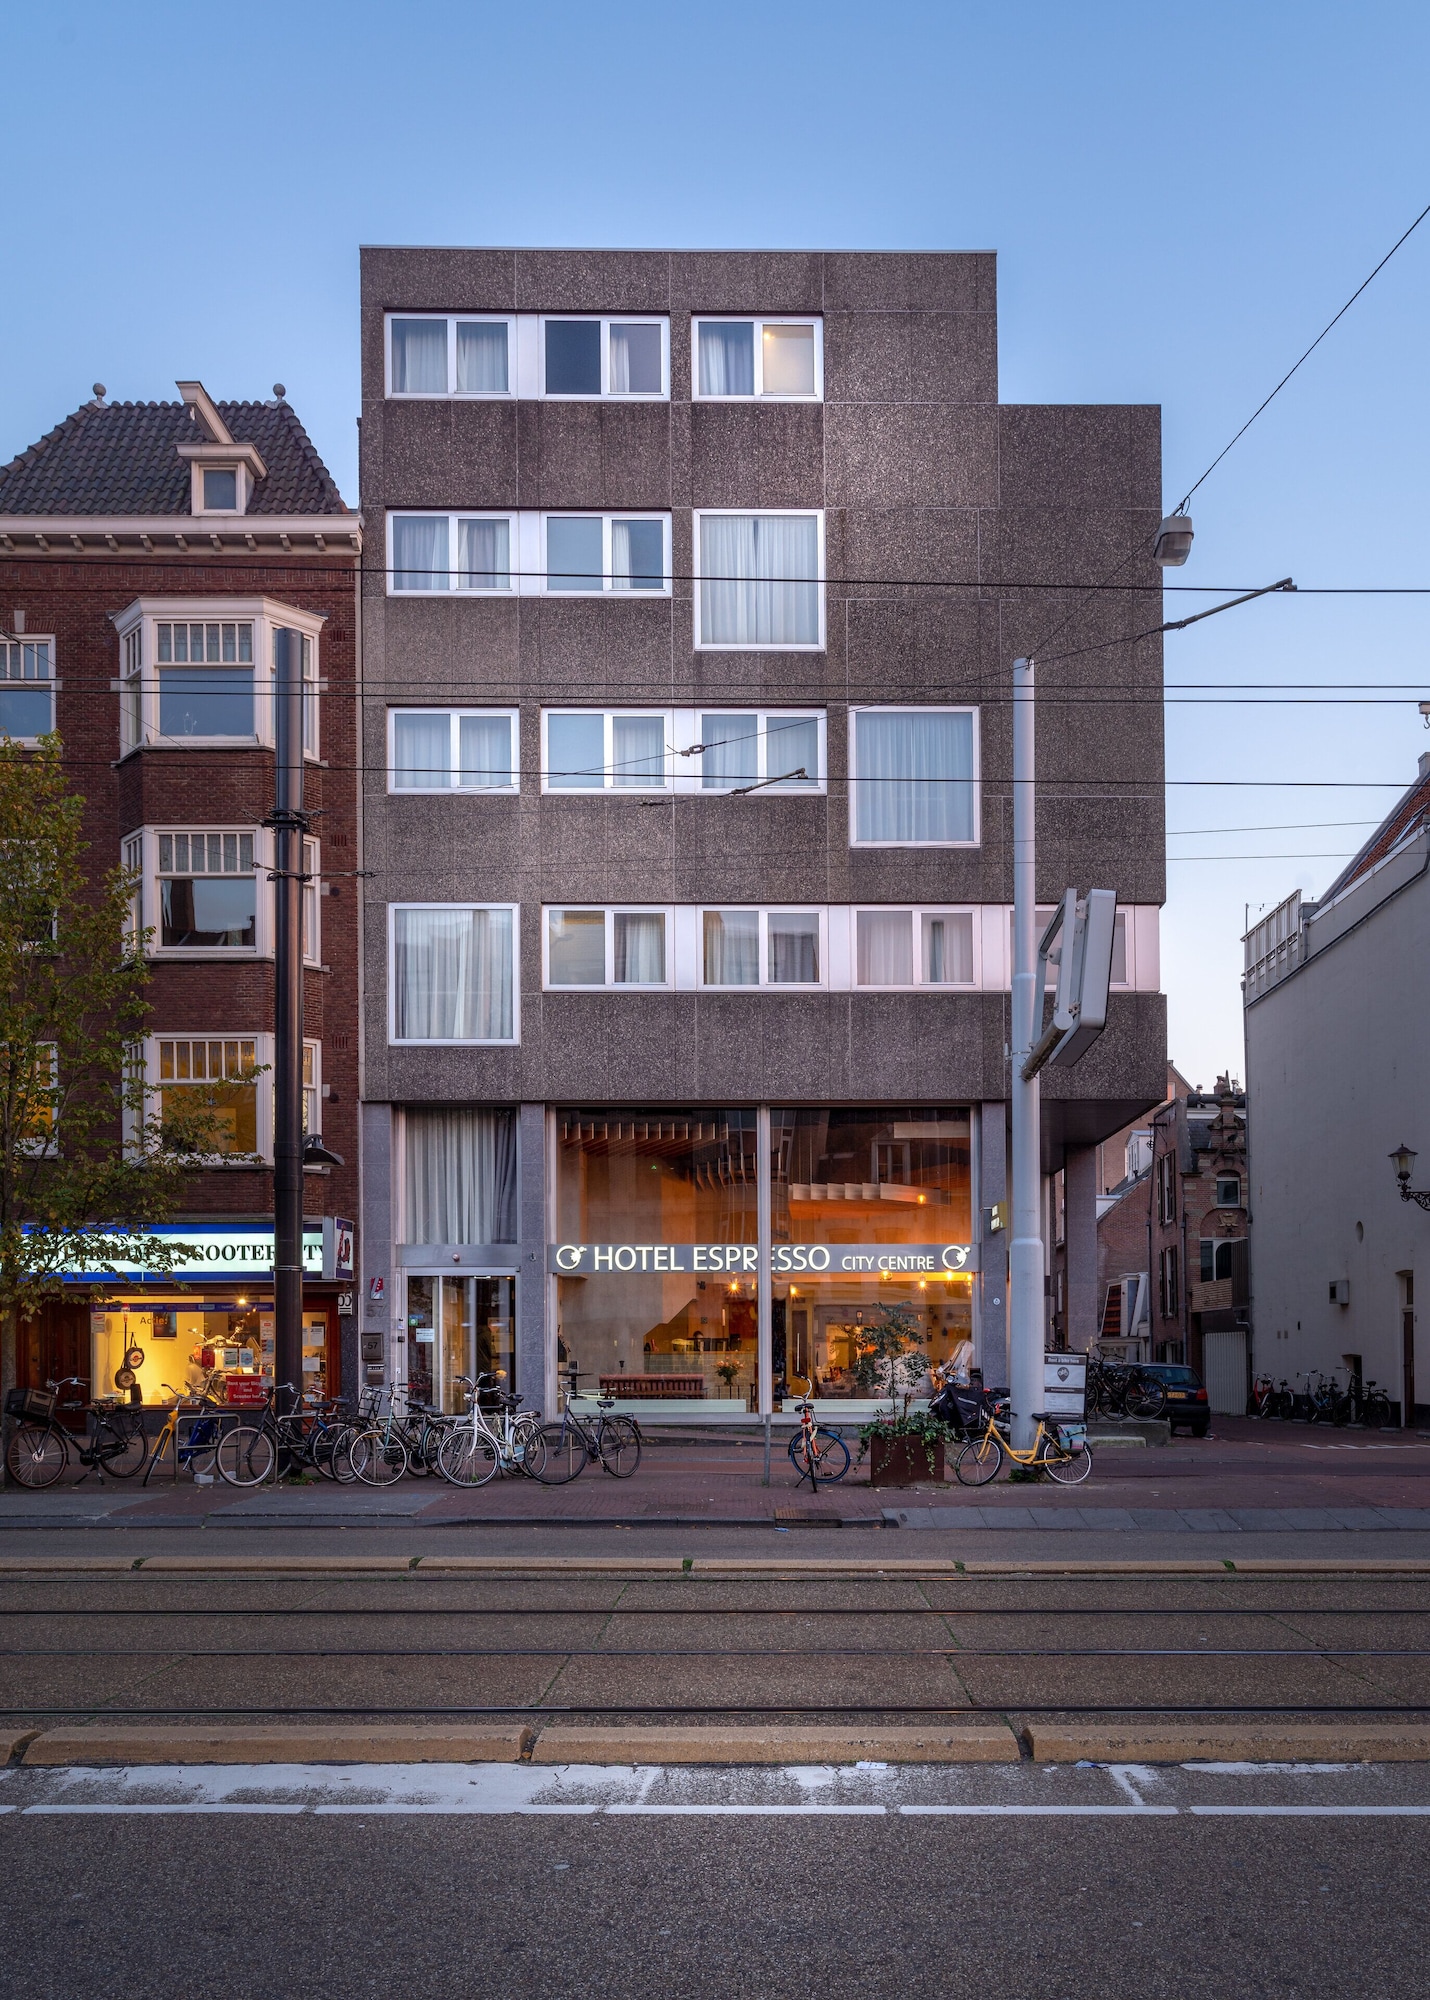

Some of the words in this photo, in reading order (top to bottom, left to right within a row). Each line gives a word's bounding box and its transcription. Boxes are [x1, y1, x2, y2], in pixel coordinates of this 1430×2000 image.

[594, 1246, 685, 1271] HOTEL
[693, 1246, 831, 1271] ESPRSSO
[841, 1256, 875, 1271] CITY
[878, 1256, 934, 1271] CENTRE
[366, 1303, 388, 1318] 57
[367, 1341, 378, 1350] 57
